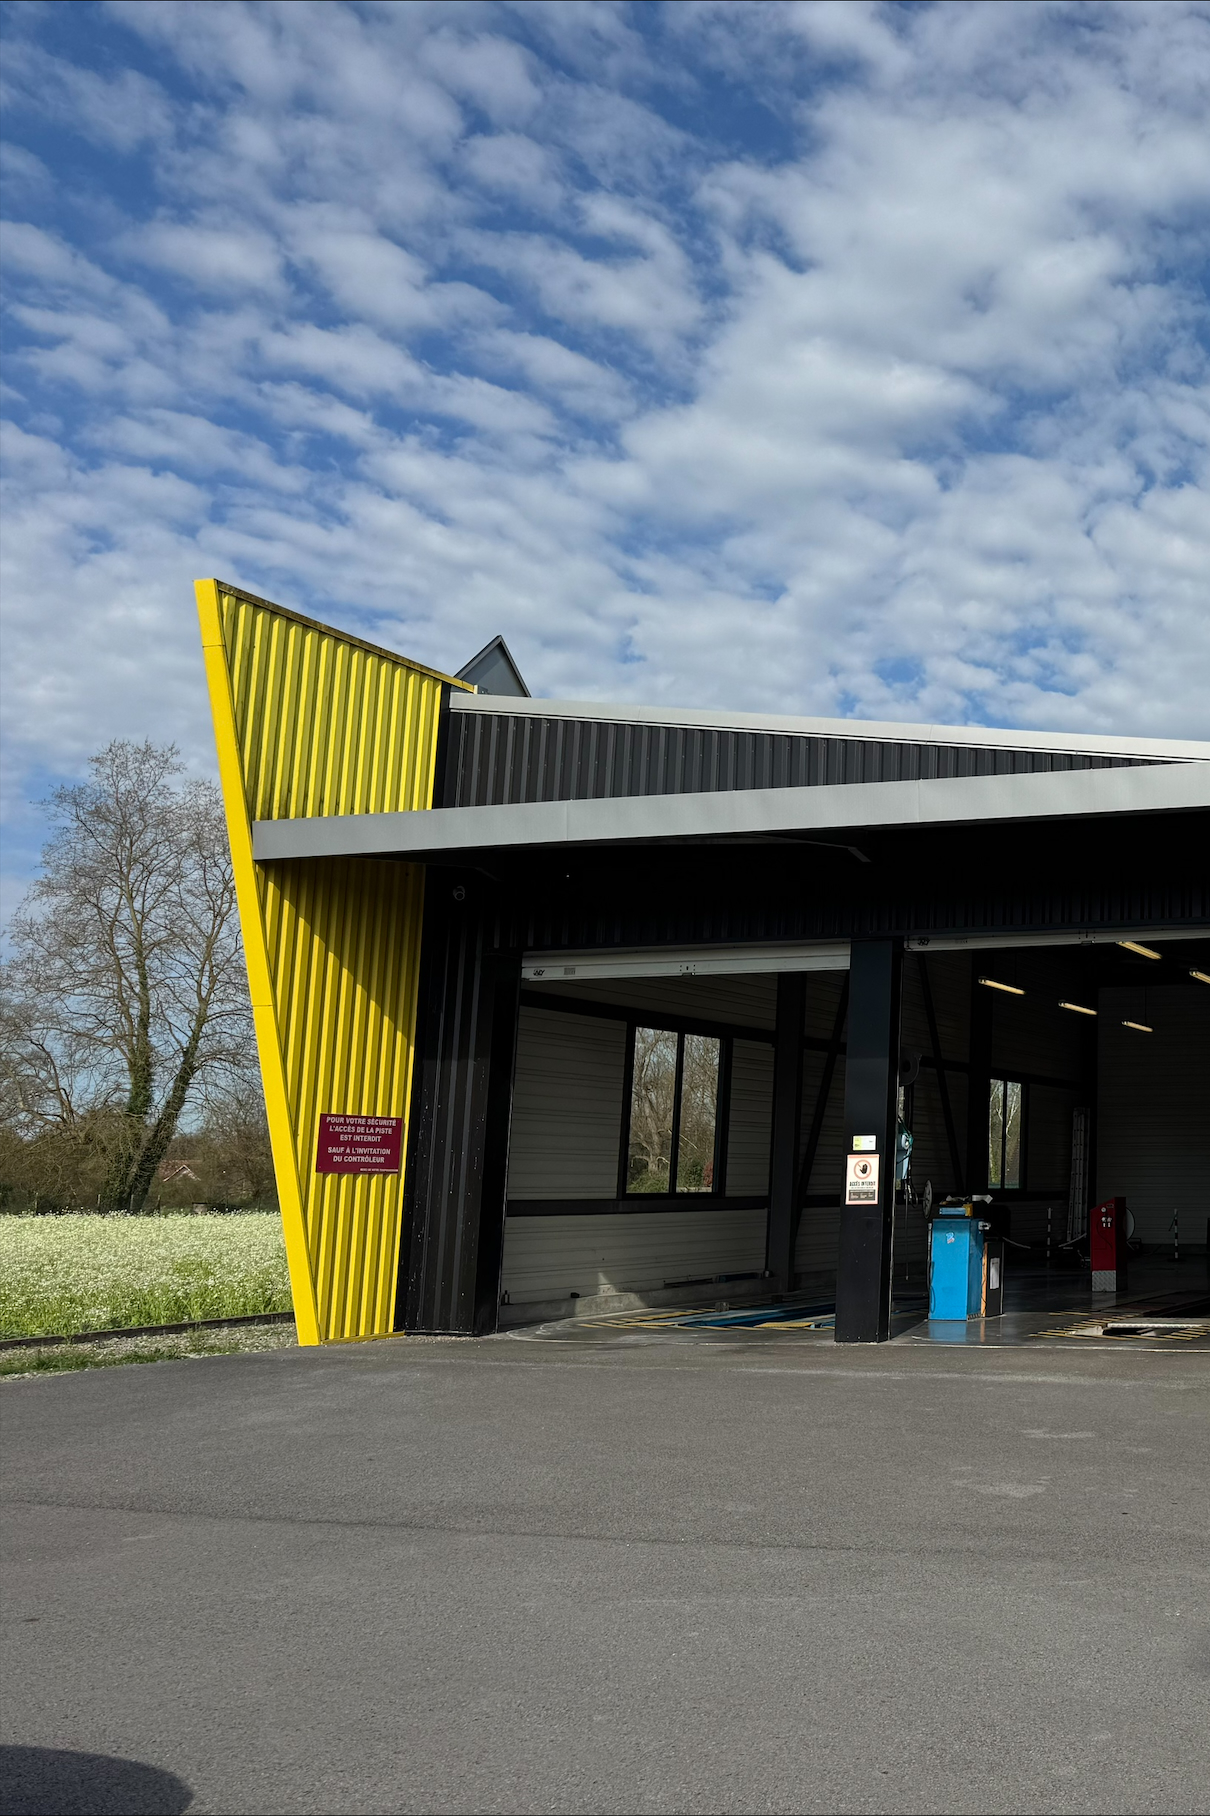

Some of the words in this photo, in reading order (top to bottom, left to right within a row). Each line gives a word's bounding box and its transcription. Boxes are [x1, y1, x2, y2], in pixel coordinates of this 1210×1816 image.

[326, 1116, 345, 1124] POUR
[346, 1117, 366, 1125] VOTRE
[353, 1134, 382, 1142] INTERDIT
[327, 1146, 345, 1154] SAUF
[346, 1146, 351, 1154] À
[352, 1147, 391, 1155] L'INVITATION
[343, 1155, 385, 1163] CONTRÔLEUR
